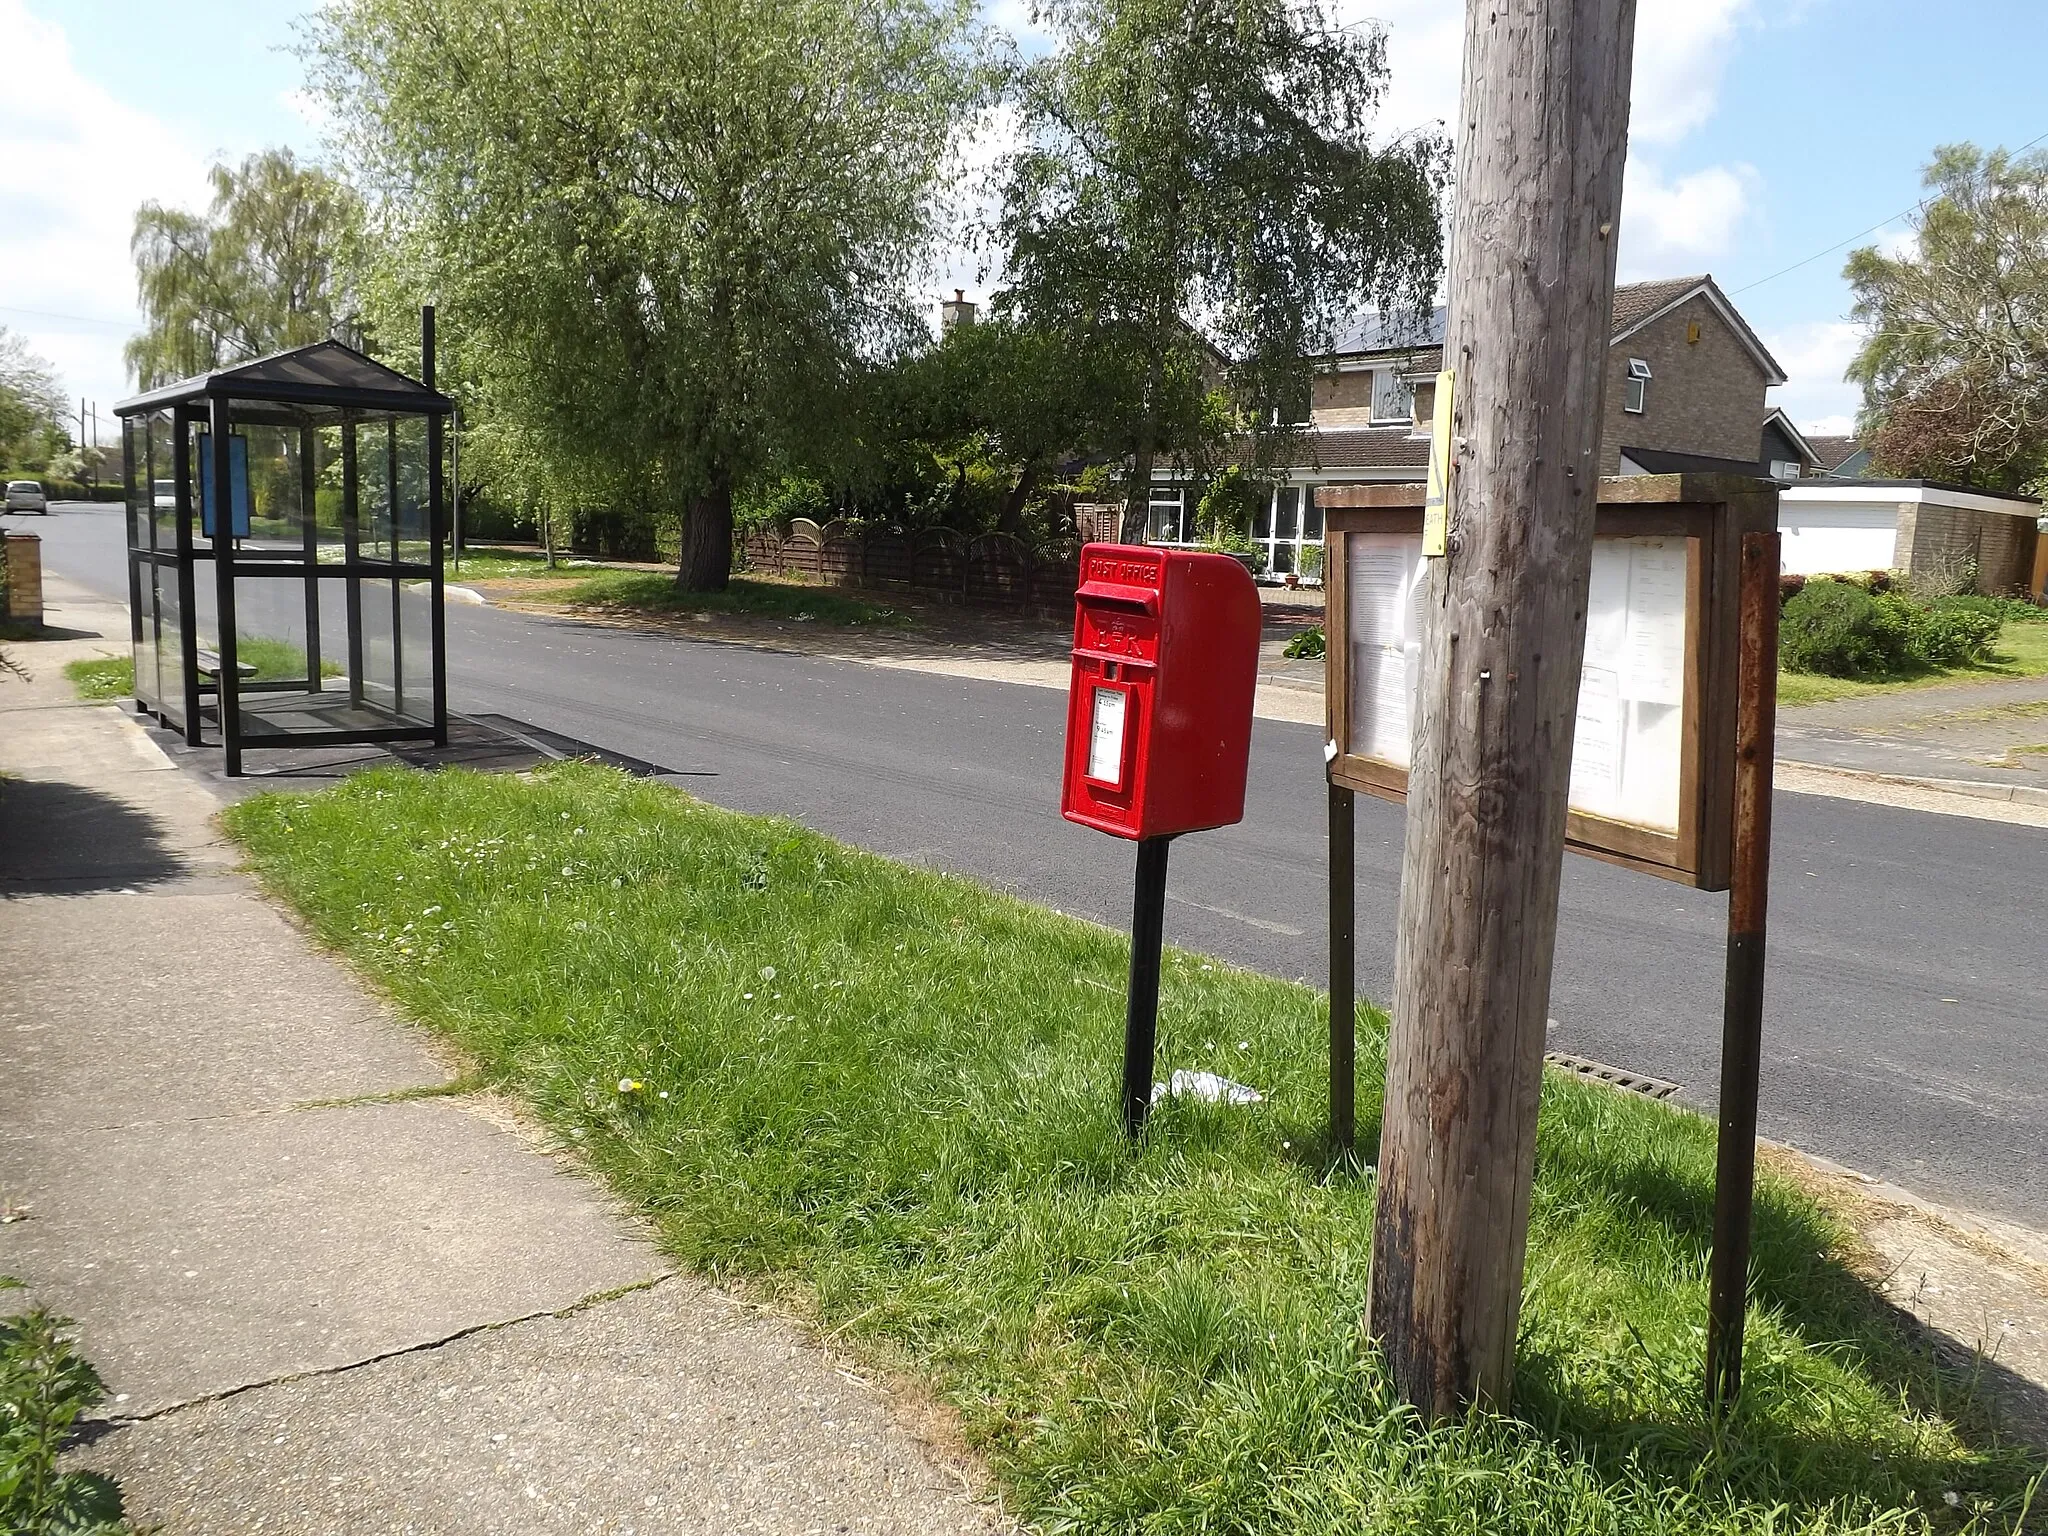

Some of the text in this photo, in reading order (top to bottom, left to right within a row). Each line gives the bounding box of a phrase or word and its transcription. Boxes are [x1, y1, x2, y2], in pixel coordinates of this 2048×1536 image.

[1426, 512, 1443, 525] EATH
[1090, 559, 1158, 584] POST OFFICE
